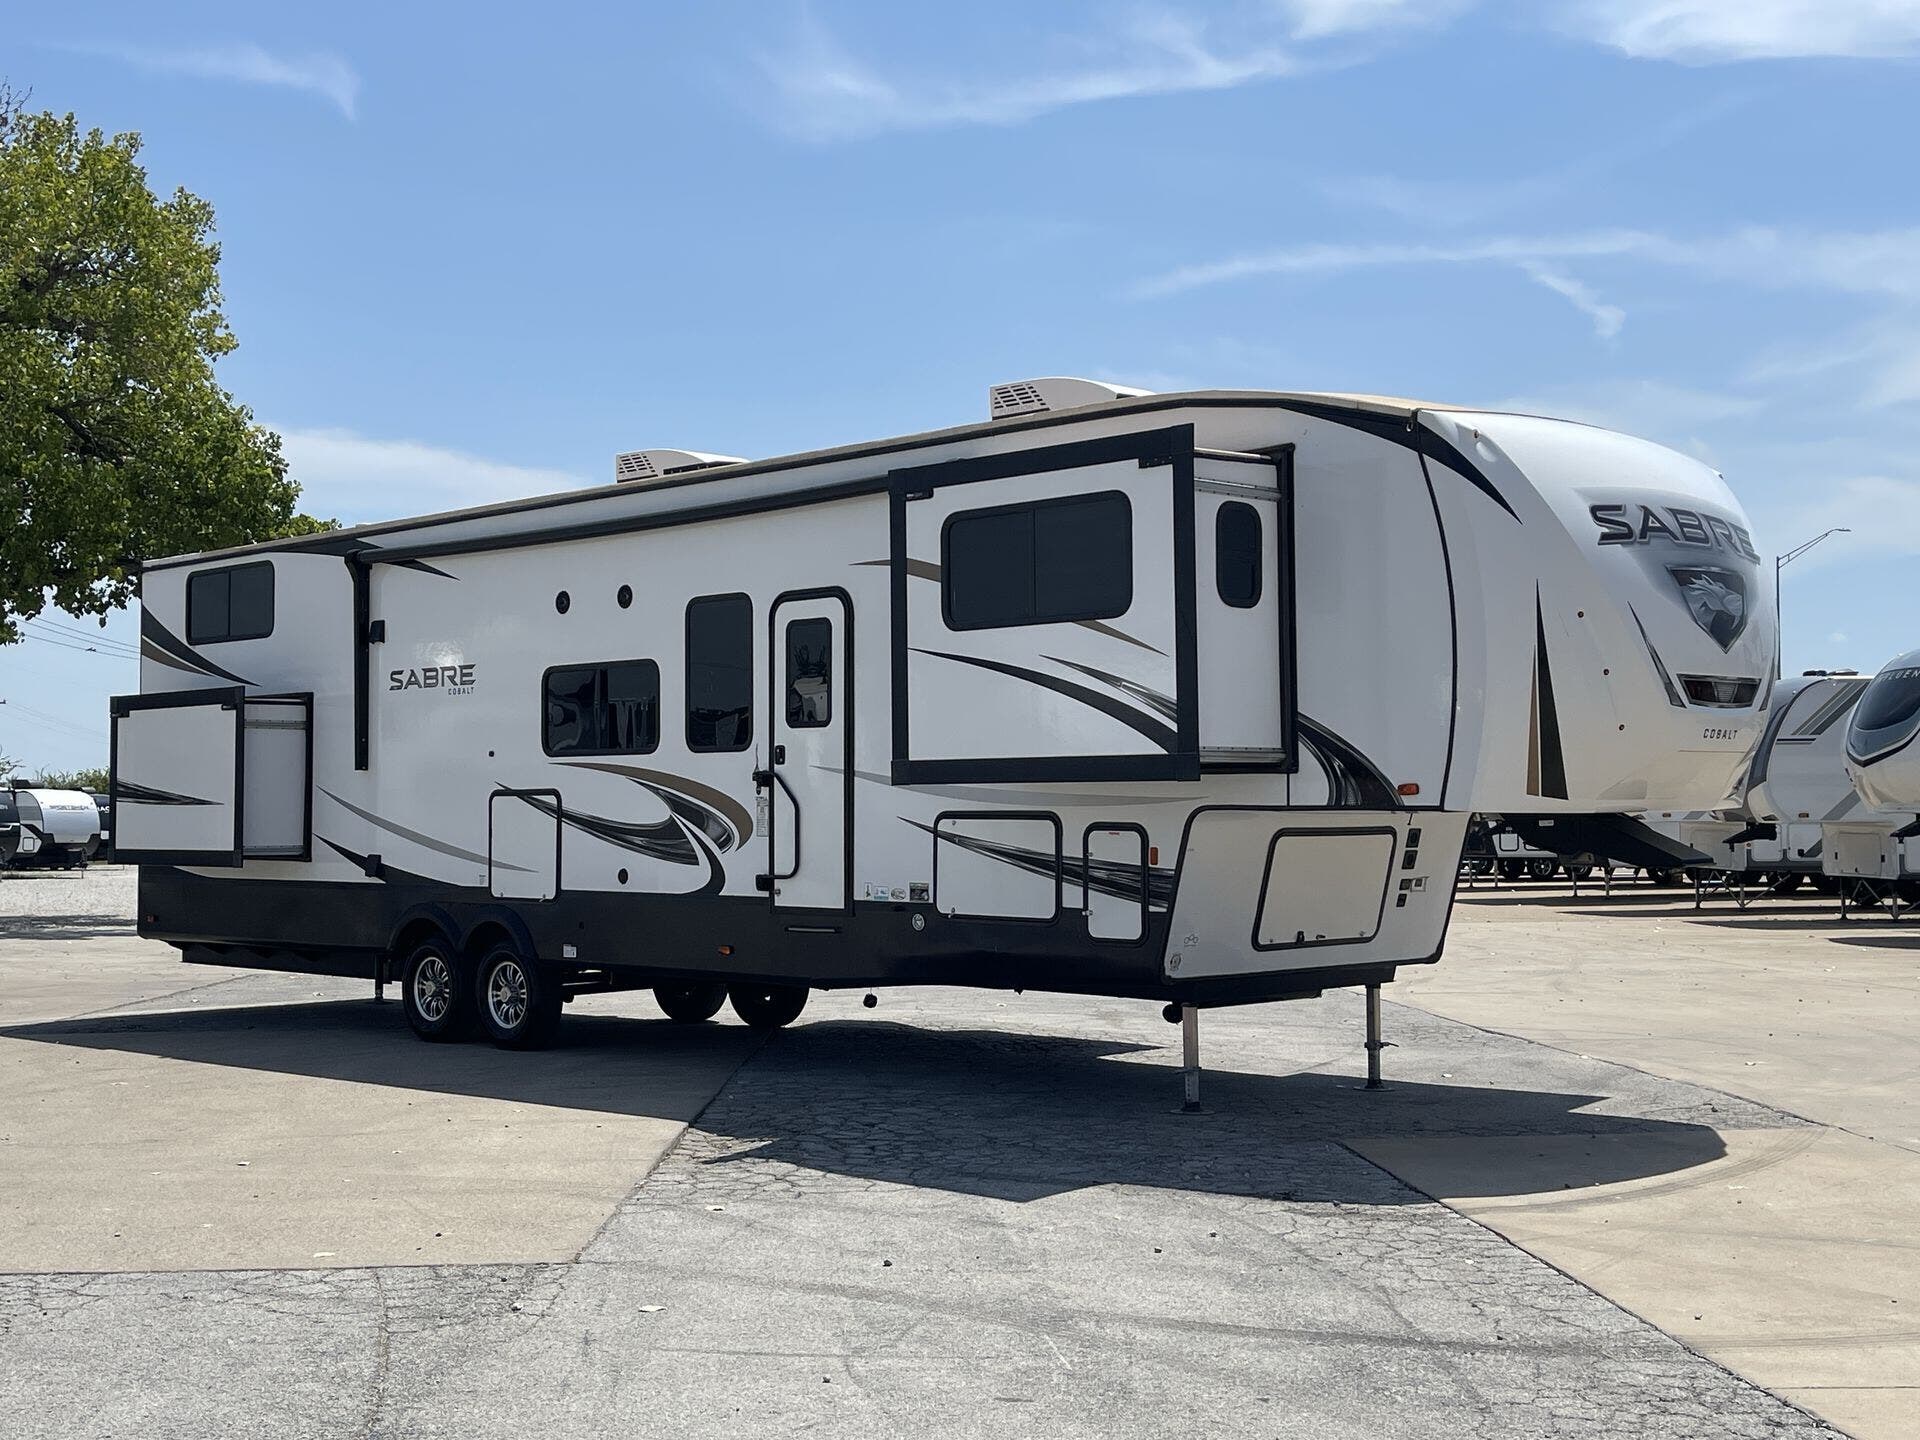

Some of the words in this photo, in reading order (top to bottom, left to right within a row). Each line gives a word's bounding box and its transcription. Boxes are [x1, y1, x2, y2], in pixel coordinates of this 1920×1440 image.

[1590, 504, 1760, 565] SABRE
[389, 664, 476, 691] SABRE
[447, 687, 475, 696] COBALT
[1703, 728, 1738, 740] COBALT
